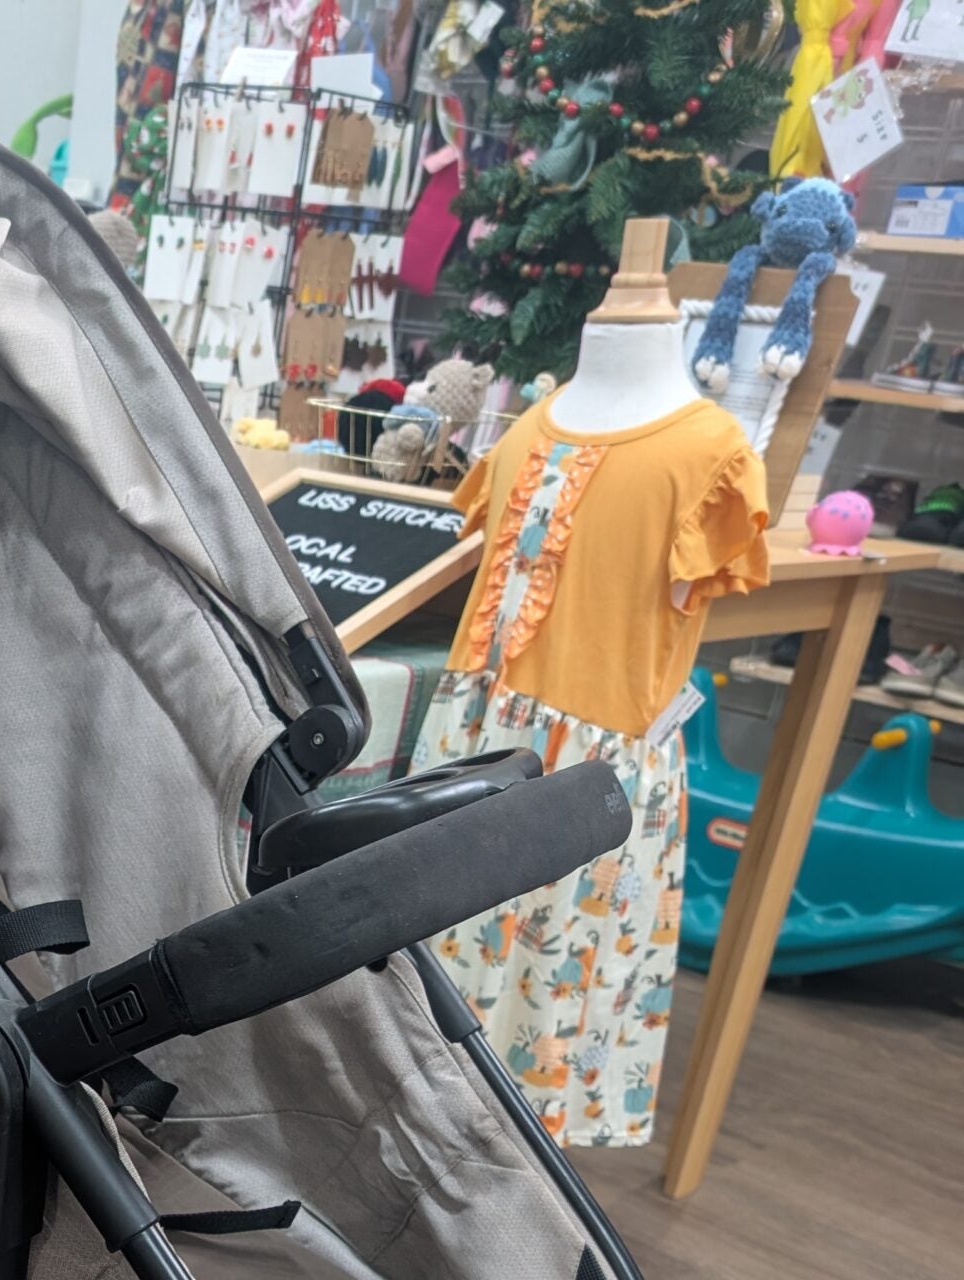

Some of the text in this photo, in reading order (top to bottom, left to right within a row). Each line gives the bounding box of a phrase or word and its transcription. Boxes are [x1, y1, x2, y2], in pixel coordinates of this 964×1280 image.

[297, 488, 464, 533] LISS STITCHES
[286, 534, 357, 563] OCAL
